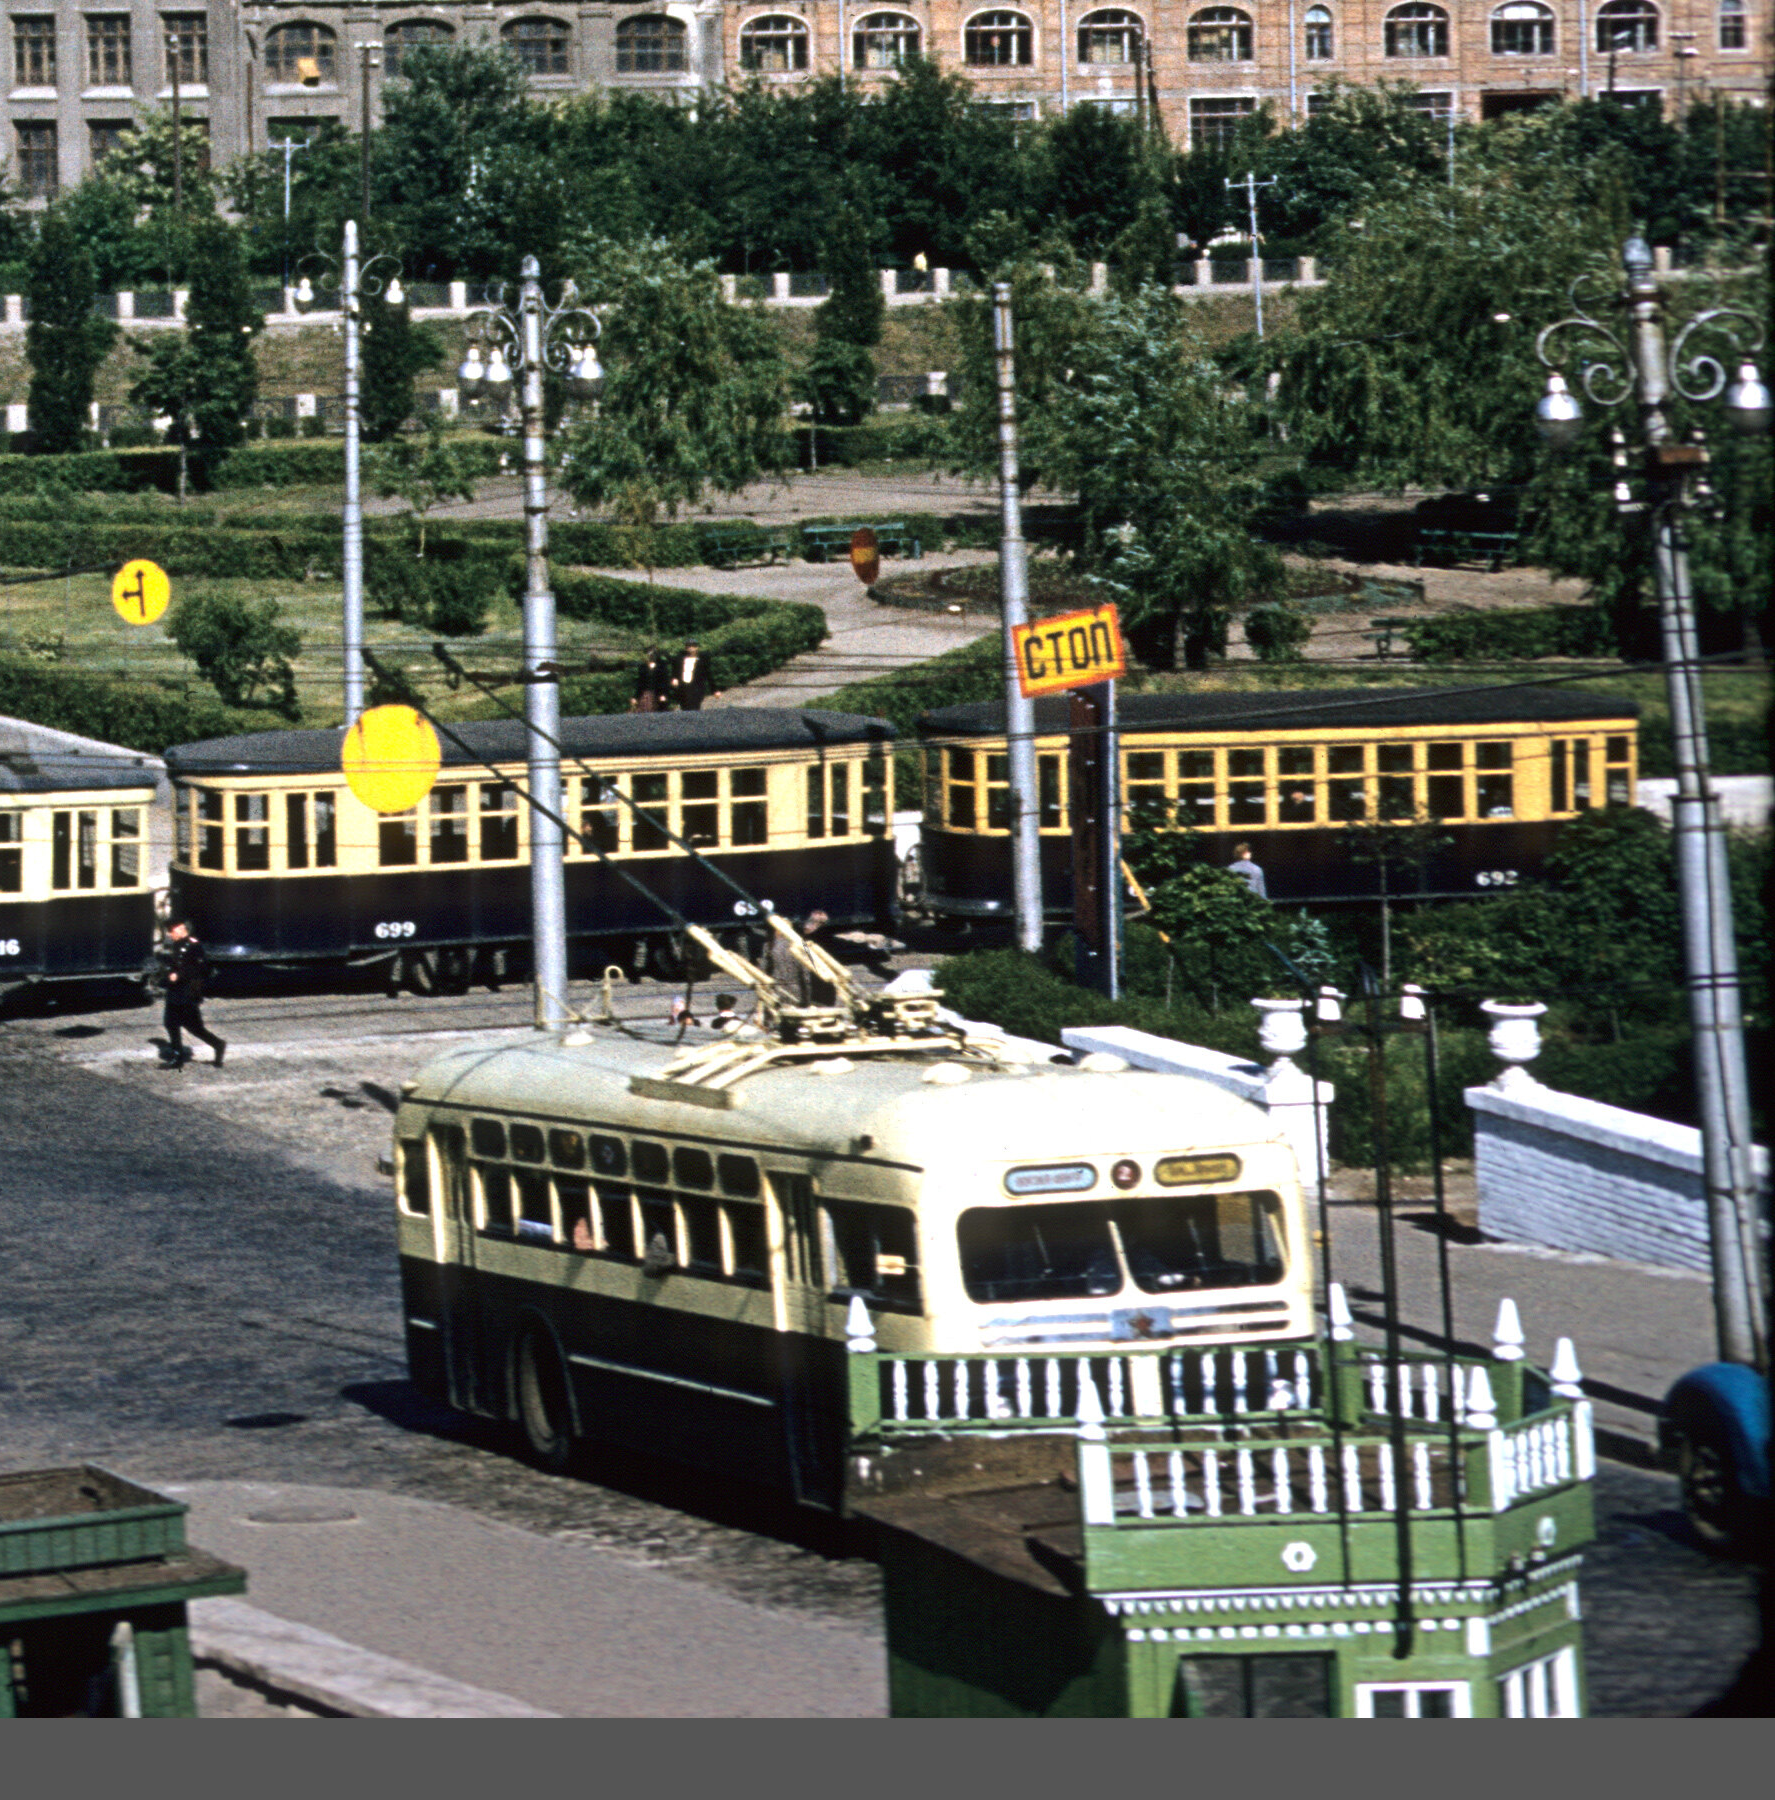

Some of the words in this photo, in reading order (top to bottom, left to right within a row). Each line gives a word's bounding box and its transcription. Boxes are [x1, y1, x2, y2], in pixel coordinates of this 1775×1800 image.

[1024, 621, 1114, 680] СТОП
[1476, 870, 1519, 886] 692
[375, 921, 416, 938] 699
[1118, 1165, 1132, 1181] 2
